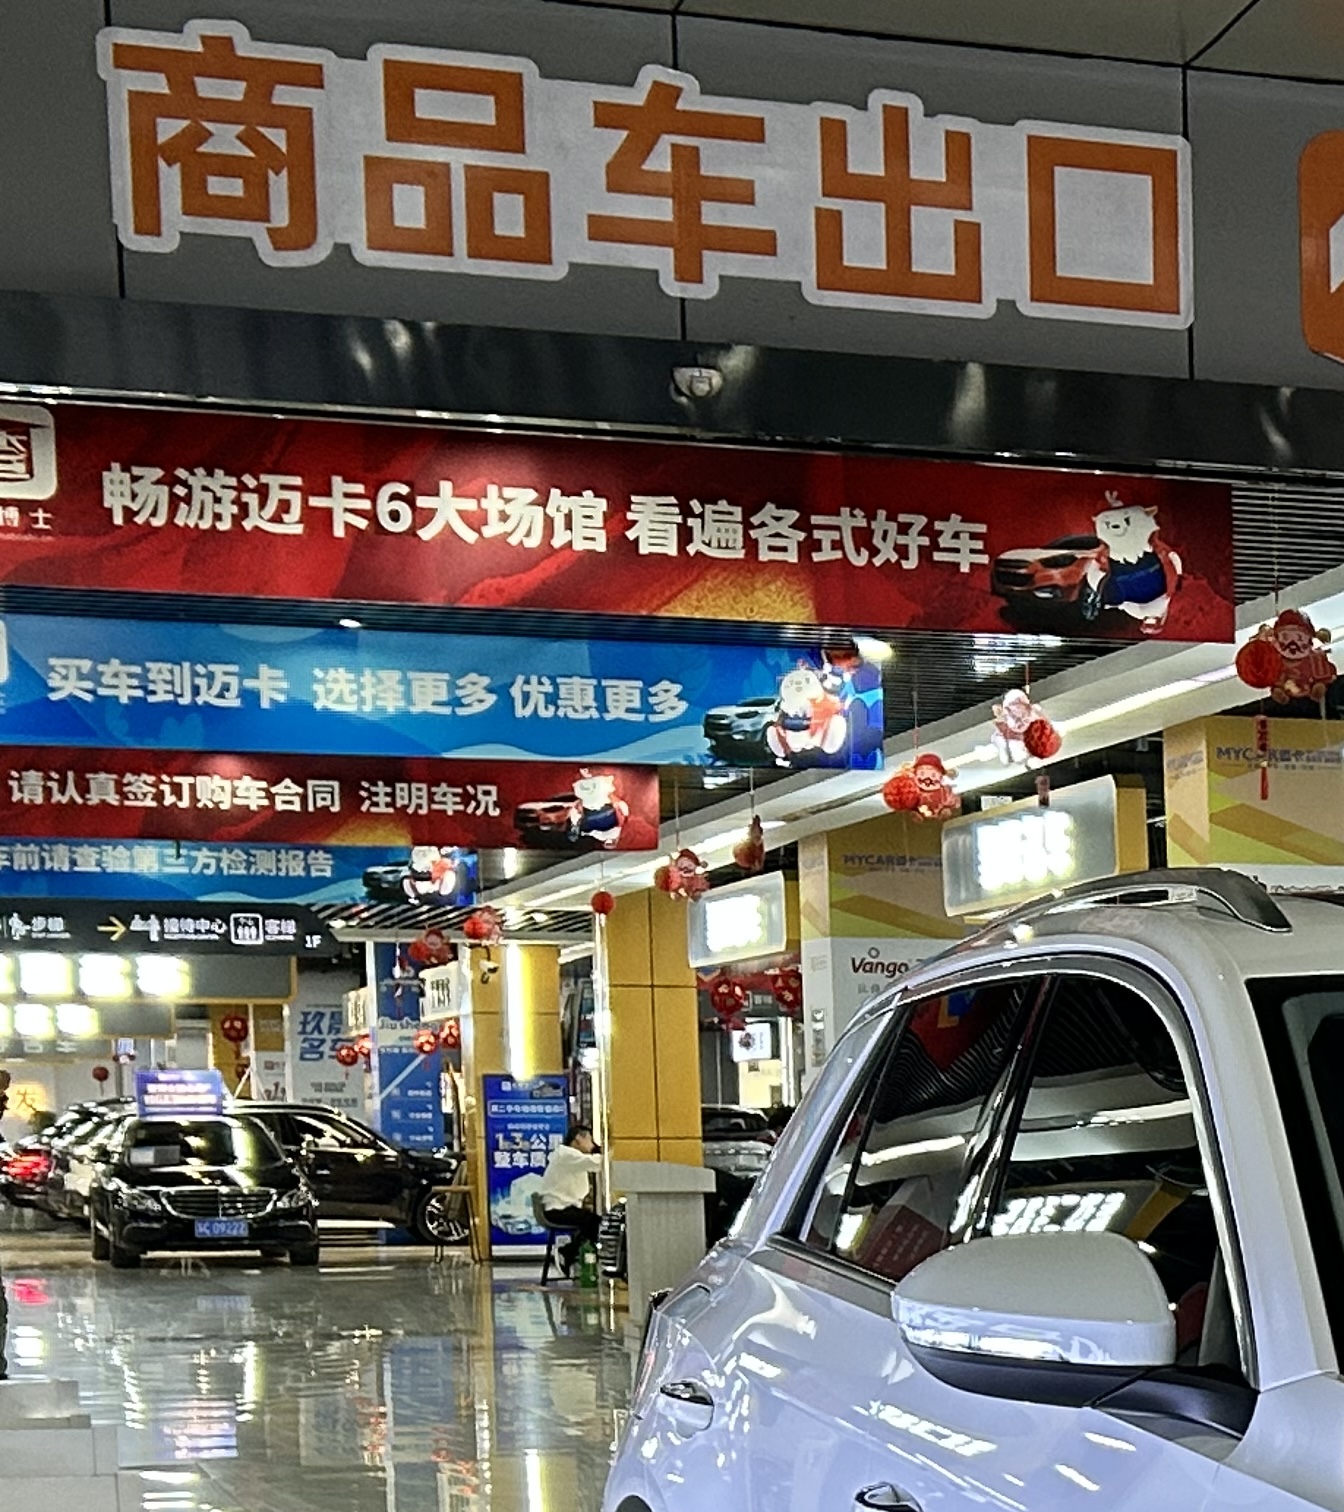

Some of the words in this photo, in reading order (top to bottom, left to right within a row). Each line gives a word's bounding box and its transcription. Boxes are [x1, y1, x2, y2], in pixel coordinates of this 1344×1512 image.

[108, 32, 1183, 316] 商品车出口
[102, 461, 607, 553] 畅游迈卡6大场馆
[625, 495, 990, 573] 看遍各式好车
[47, 657, 289, 709] 买车到迈卡
[312, 668, 497, 716] 选择更多
[509, 673, 689, 722] 优惠更多
[8, 768, 341, 813] 请认真签订购车合同
[359, 780, 500, 816] 注明车况
[851, 956, 909, 978] Vango
